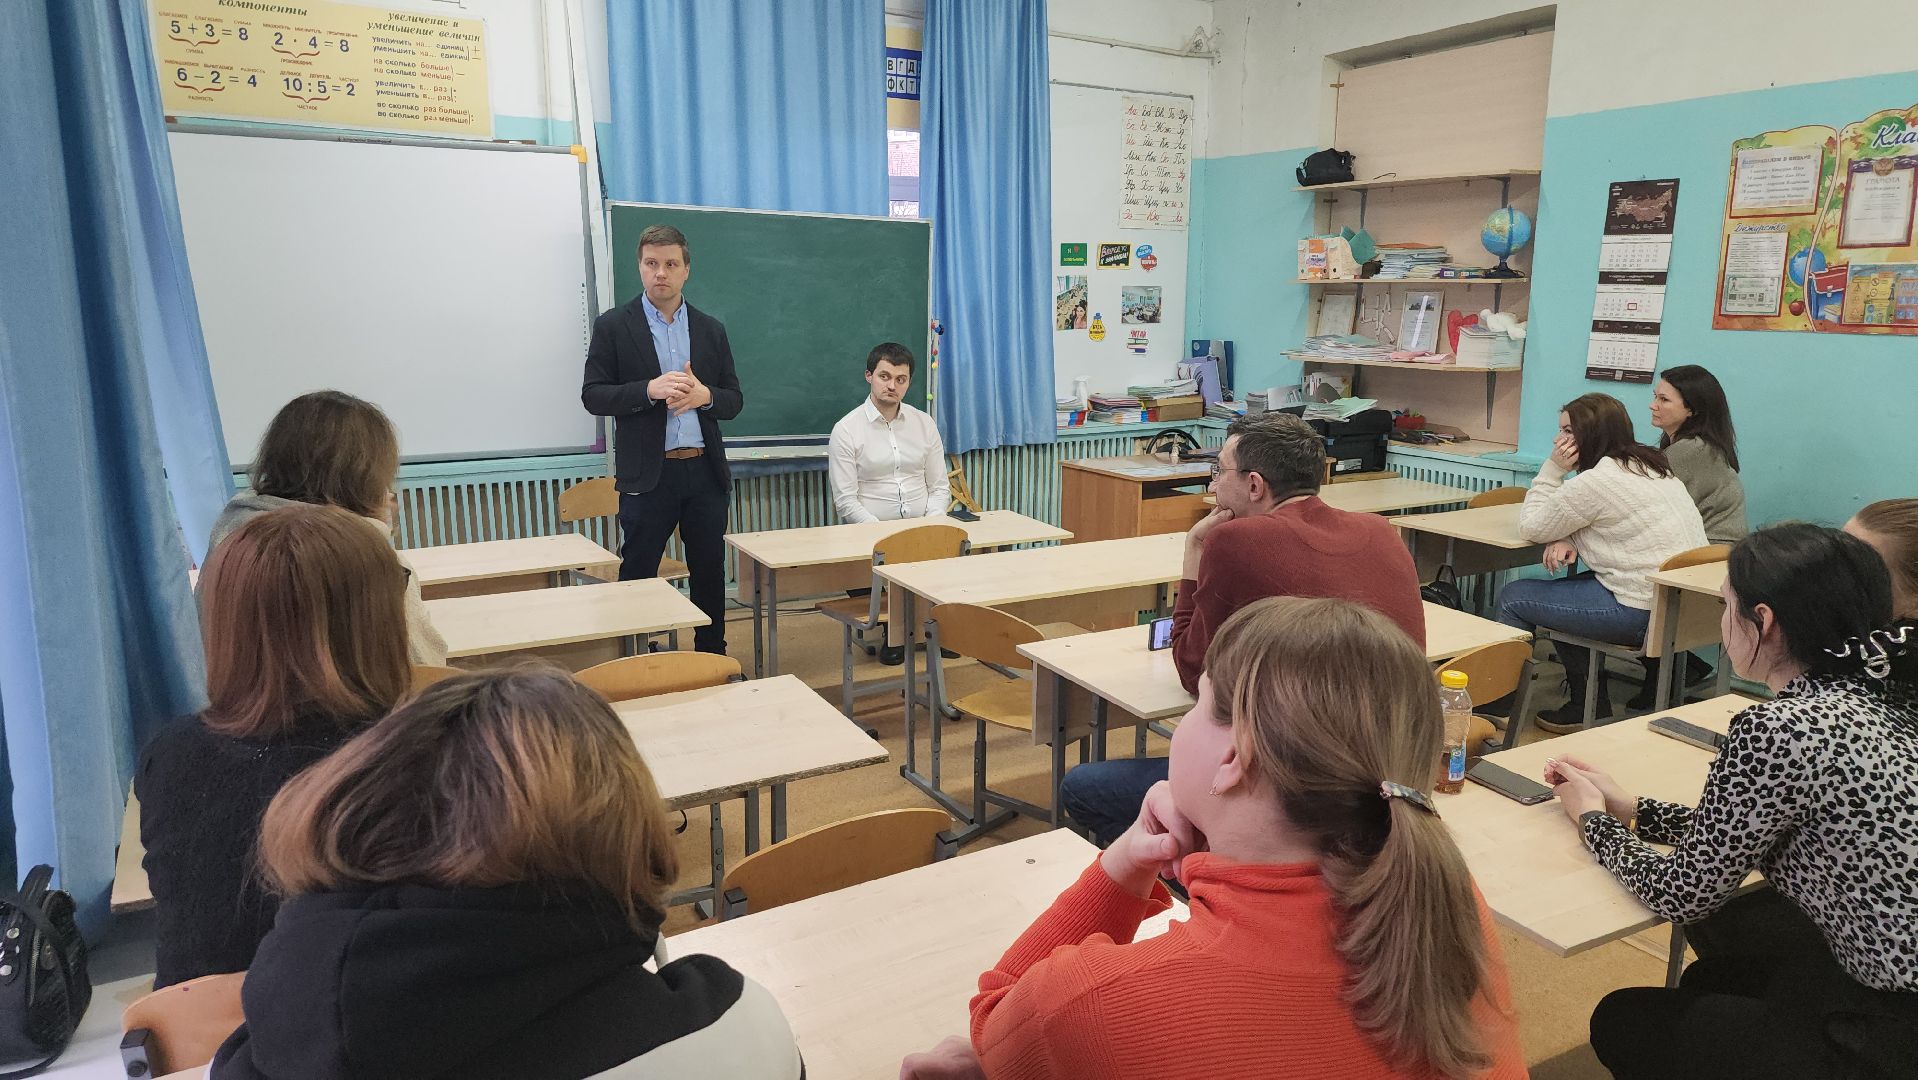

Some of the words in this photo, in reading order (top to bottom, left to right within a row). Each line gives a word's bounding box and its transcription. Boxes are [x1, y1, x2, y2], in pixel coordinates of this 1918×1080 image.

[218, 0, 307, 17] компоненты
[388, 12, 449, 26] увеличение
[171, 20, 181, 34] 5
[187, 22, 198, 34] +
[205, 23, 215, 37] 3
[238, 27, 249, 41] 8
[366, 21, 434, 37] уменьшение
[438, 30, 481, 42] величин
[273, 32, 284, 46] 2
[308, 36, 318, 49] 4
[339, 39, 350, 52] 8
[372, 36, 412, 47] увеличить
[436, 43, 465, 52] единиц
[372, 45, 416, 56] уменьшить
[384, 59, 417, 68] сколько
[420, 61, 450, 71] больше
[887, 59, 894, 71] В
[898, 60, 904, 72] Г
[908, 61, 915, 74] Д
[177, 67, 188, 81] 6
[210, 70, 221, 84] 2
[228, 75, 239, 83] =
[247, 74, 257, 88] 4
[385, 68, 417, 77] сколько
[420, 72, 452, 81] меньше
[283, 77, 303, 91] 10
[317, 80, 327, 94] 5
[345, 83, 356, 96] 2
[375, 80, 416, 90] увеличить
[433, 85, 448, 93] раз
[887, 76, 896, 91] Ф
[899, 79, 905, 91] К
[909, 80, 915, 92] Т
[375, 89, 420, 99] уменьшить
[437, 95, 451, 103] раз
[388, 102, 420, 111] сколько
[423, 105, 437, 113] раз
[438, 105, 468, 116] больше
[388, 112, 420, 120] сколько
[438, 116, 469, 125] меньше
[1872, 124, 1918, 147] Кла
[1734, 223, 1786, 233] Дежурство
